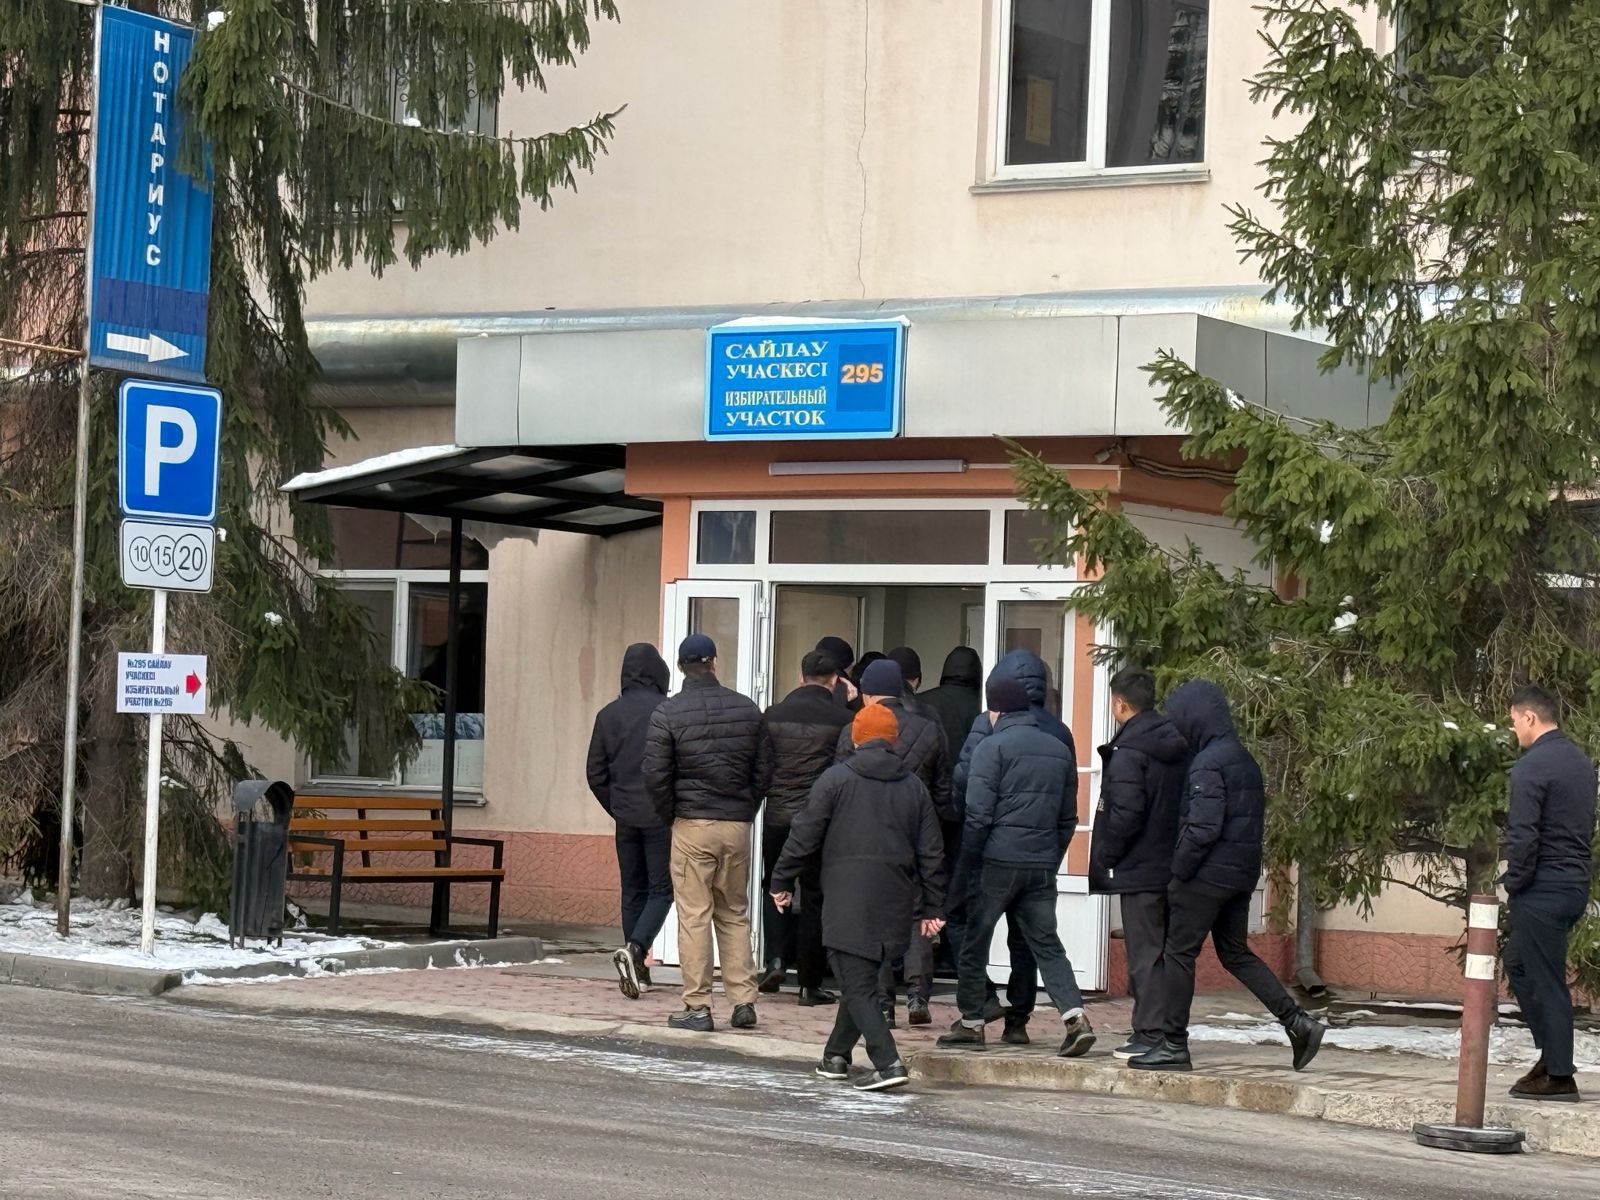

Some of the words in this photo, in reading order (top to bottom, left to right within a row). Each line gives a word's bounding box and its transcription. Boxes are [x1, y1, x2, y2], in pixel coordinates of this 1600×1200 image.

[146, 30, 170, 266] НОТАРИУС
[725, 340, 828, 359] САЙЛАУ
[726, 362, 828, 379] УЧАСКЕСІ
[840, 363, 884, 384] 295
[725, 386, 827, 407] ИЗБИРАТЕЛЬНЫЙ
[726, 410, 826, 427] УЧАСТОК
[144, 404, 198, 497] P
[134, 545, 148, 562] 10
[154, 546, 172, 567] 15
[178, 545, 203, 572] 20
[147, 658, 172, 669] САЙЛАУ
[125, 684, 180, 695] ИЗБИРАТЕЛЬНЫЙ
[125, 697, 153, 707] УЧАСТОК
